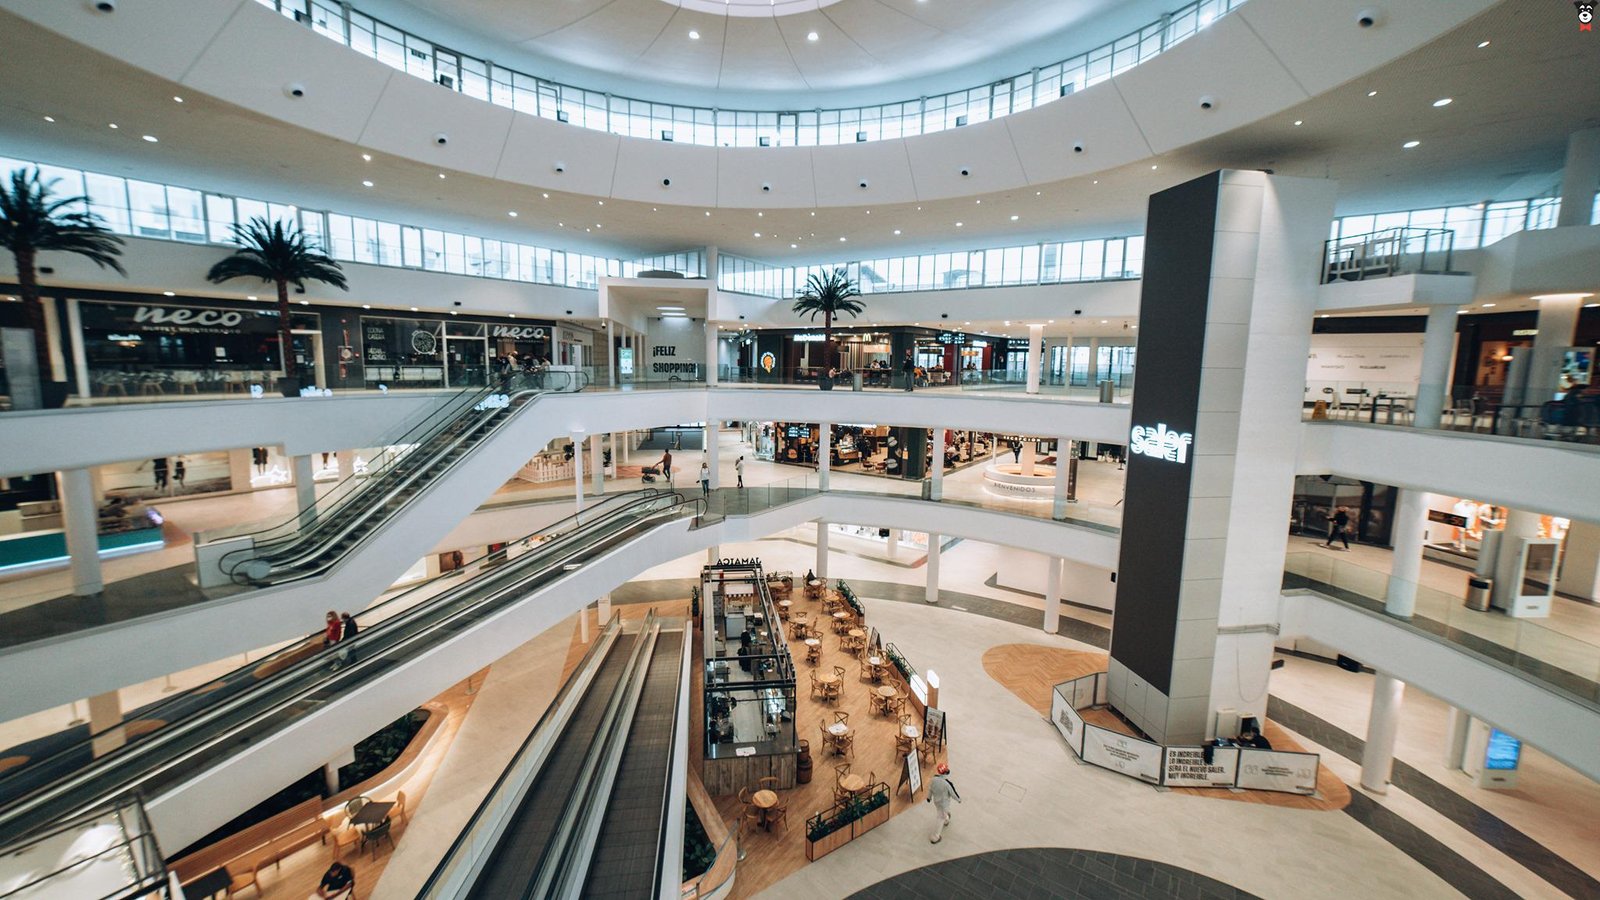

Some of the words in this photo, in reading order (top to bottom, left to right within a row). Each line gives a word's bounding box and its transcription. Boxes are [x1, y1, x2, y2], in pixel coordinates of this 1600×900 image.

[134, 306, 242, 326] neco
[493, 326, 544, 338] neco
[653, 346, 676, 357] ¡FELIZ
